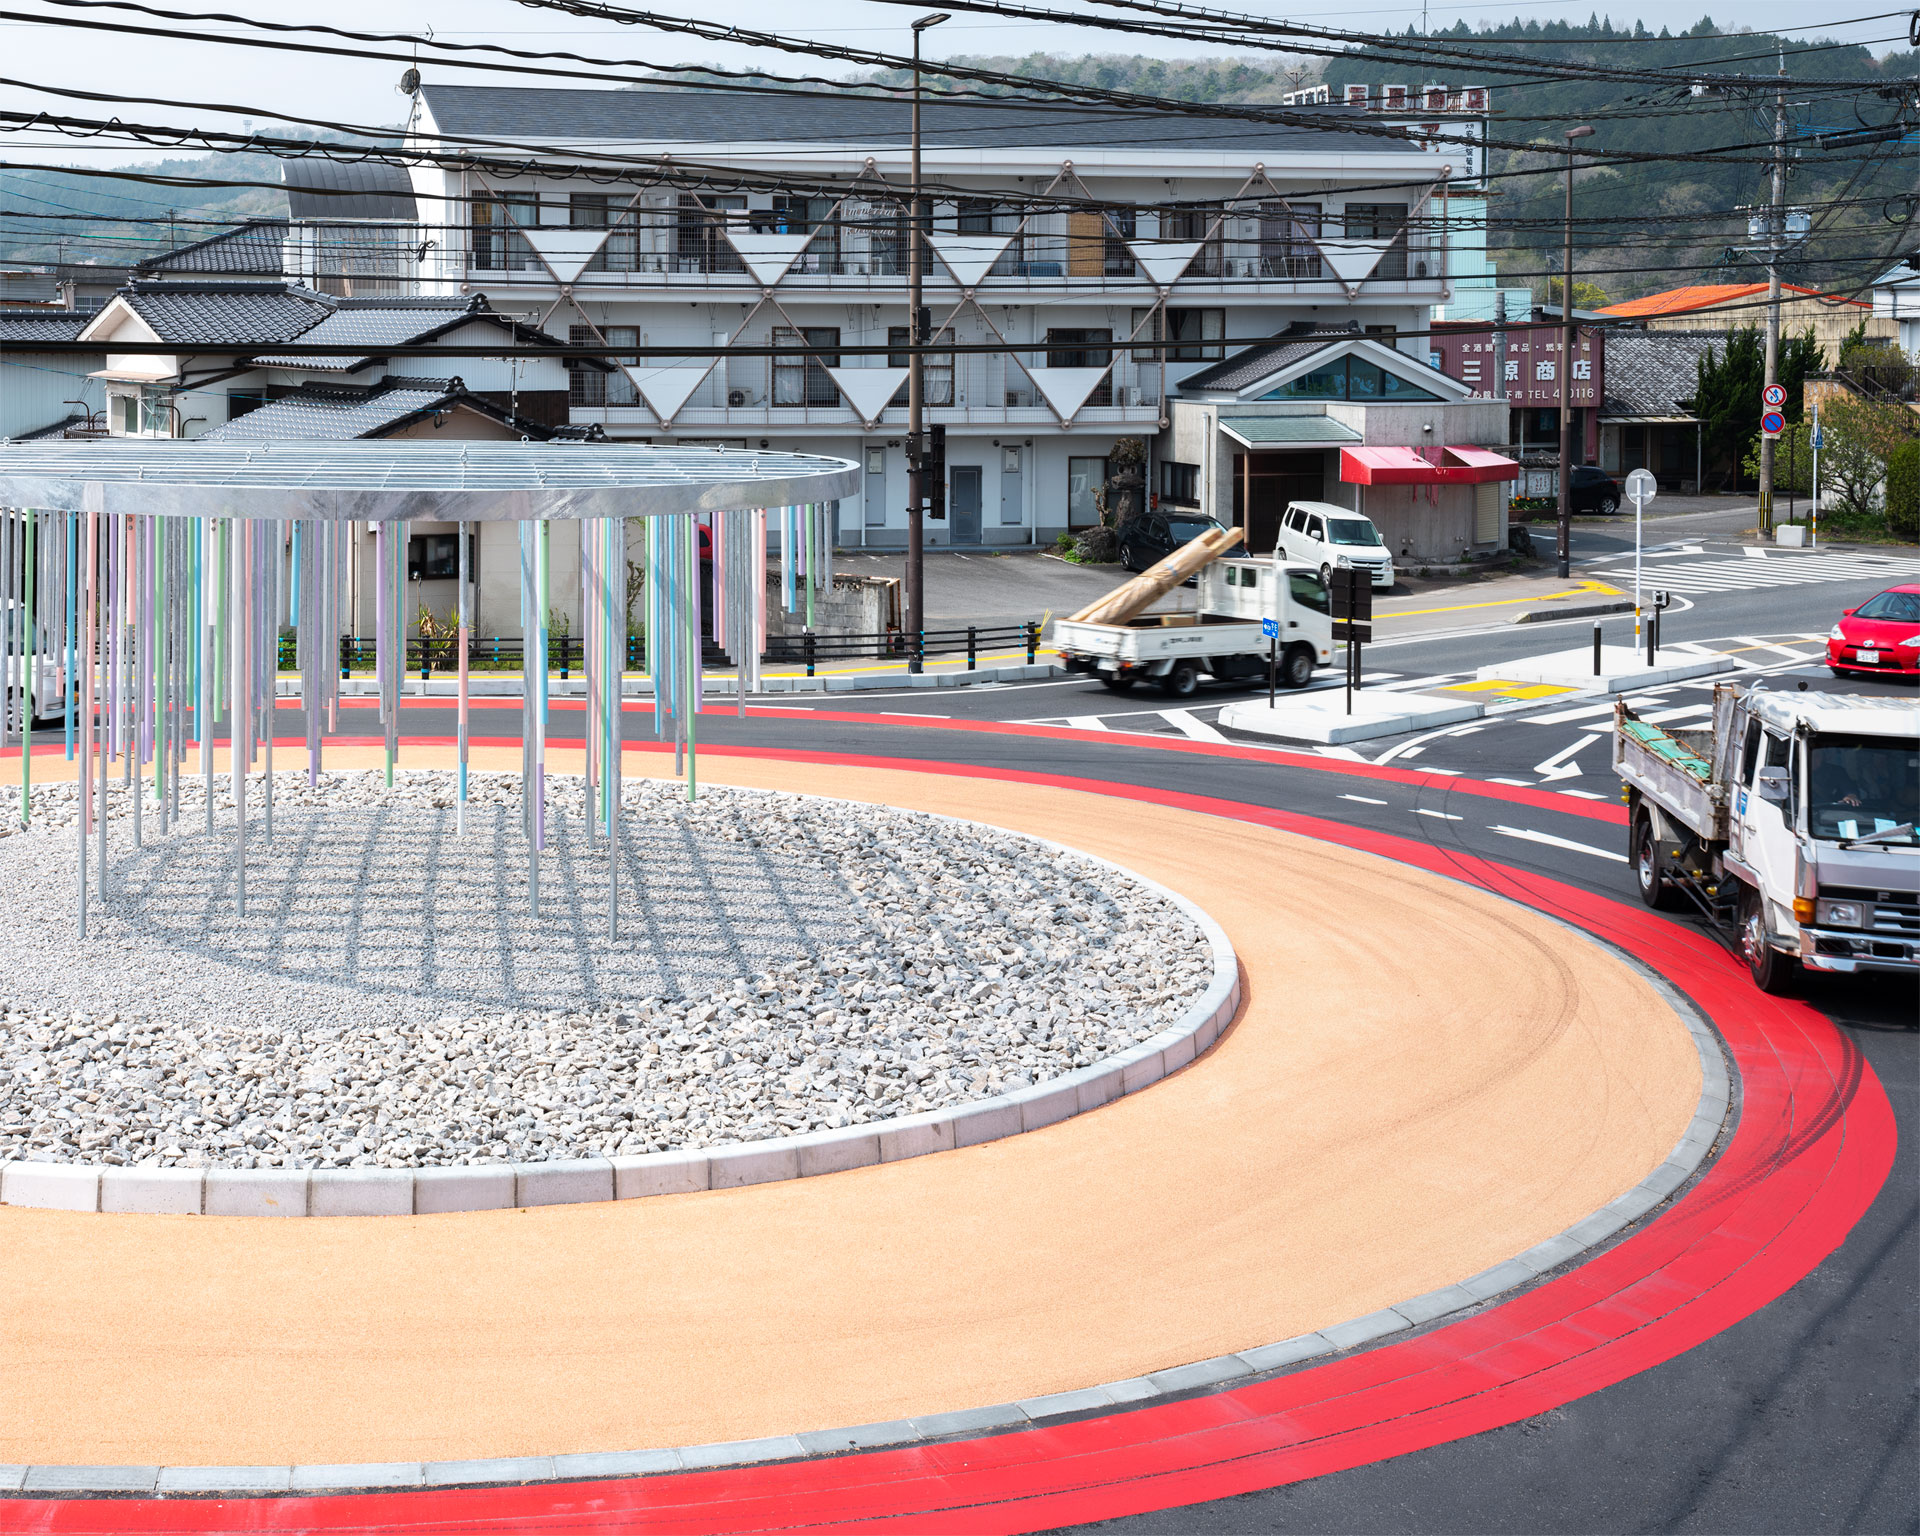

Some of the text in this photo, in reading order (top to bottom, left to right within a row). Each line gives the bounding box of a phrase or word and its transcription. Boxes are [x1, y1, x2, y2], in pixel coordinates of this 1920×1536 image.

[1462, 359, 1592, 381] 三原商店
[1528, 390, 1549, 399] TEL
